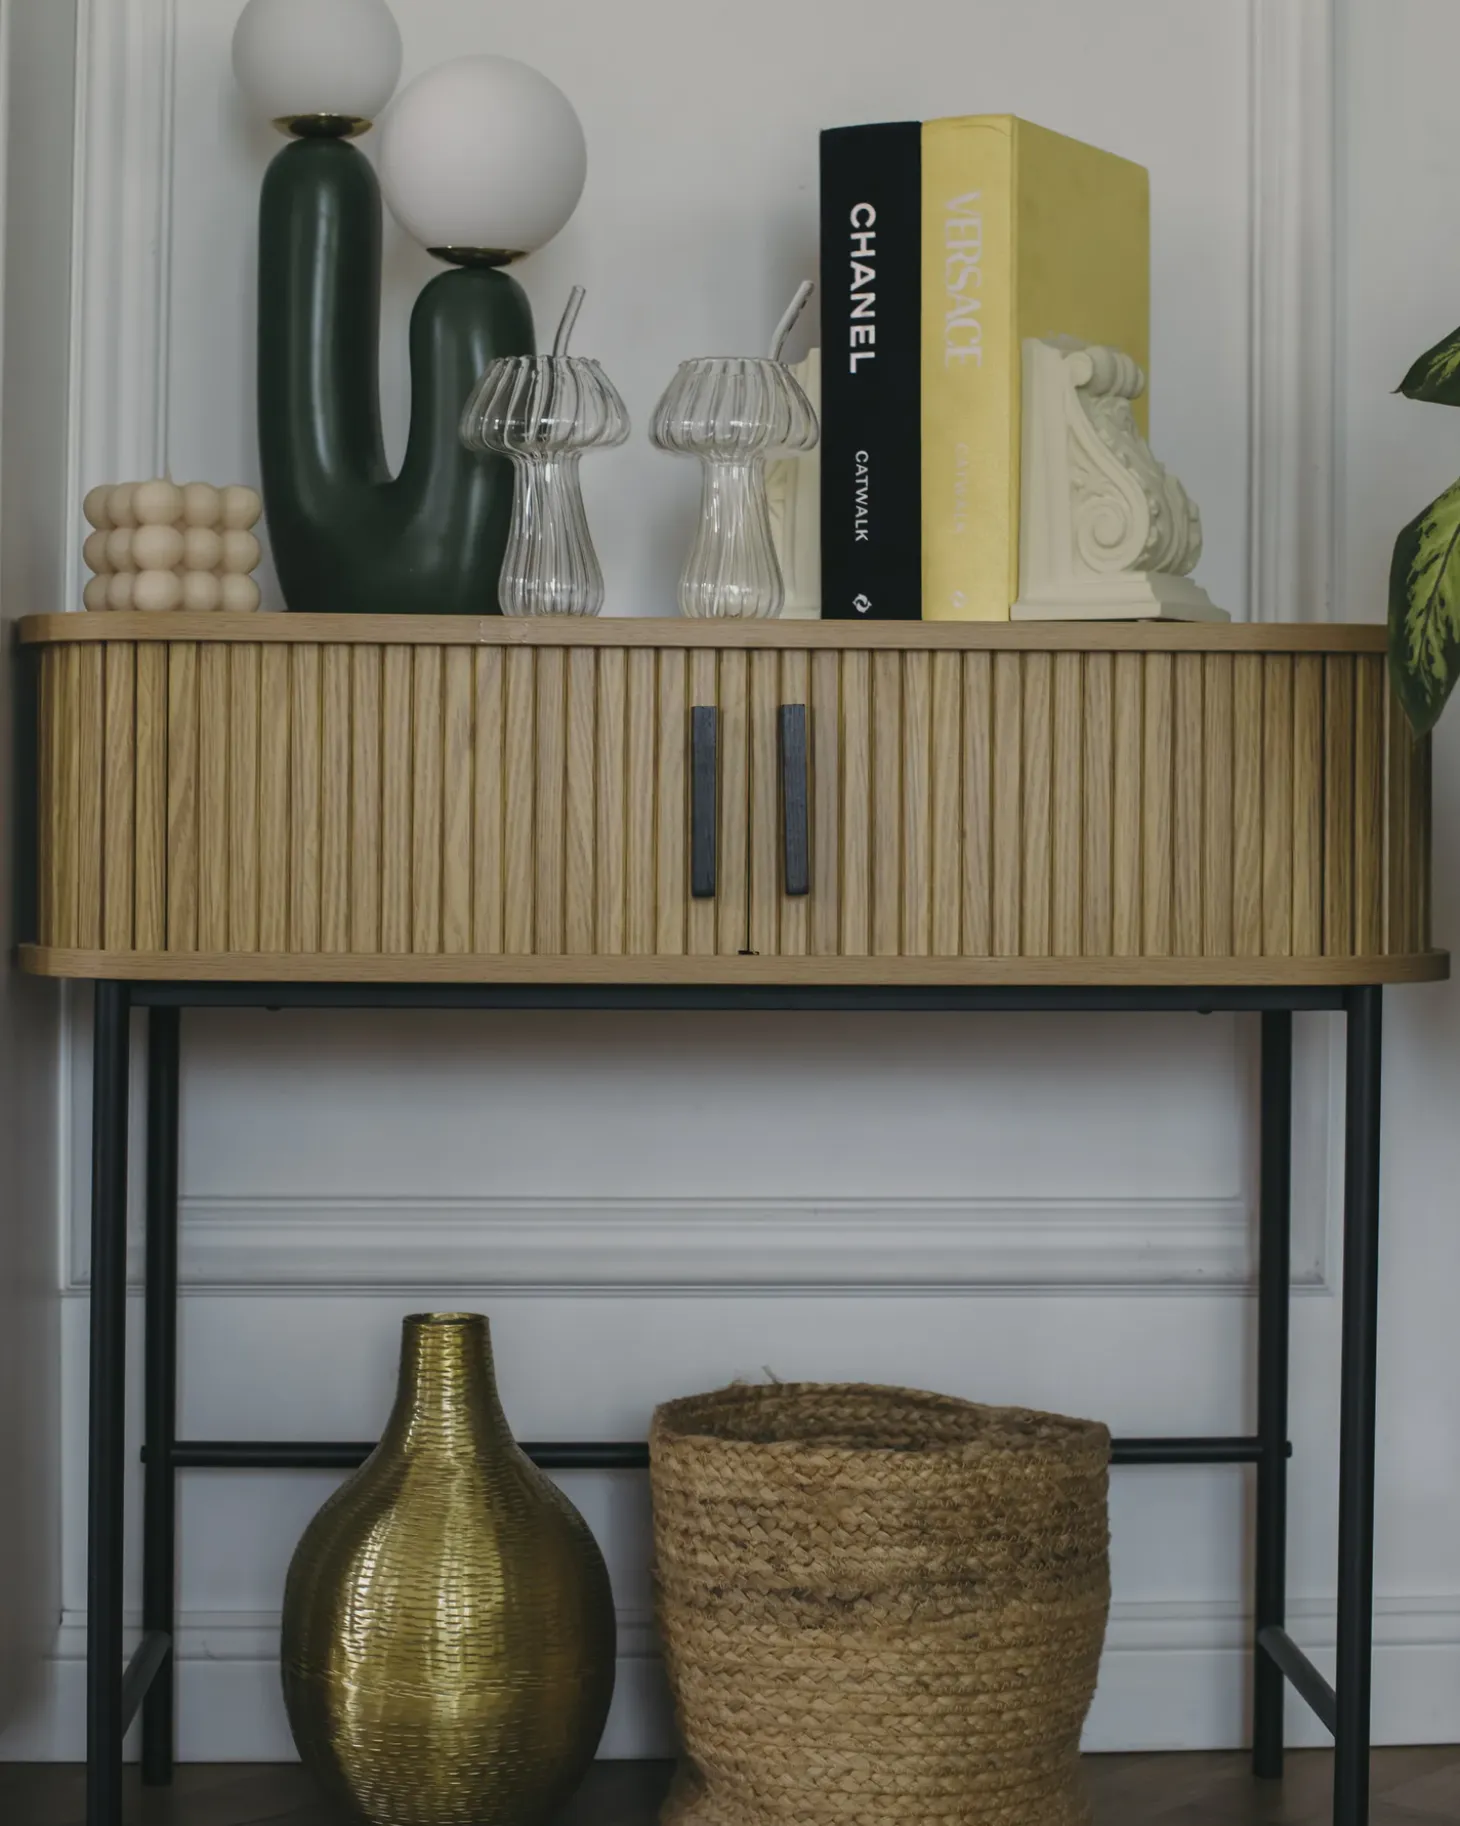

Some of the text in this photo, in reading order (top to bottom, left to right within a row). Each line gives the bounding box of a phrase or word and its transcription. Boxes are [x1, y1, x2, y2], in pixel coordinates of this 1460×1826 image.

[849, 202, 877, 374] CHANEL
[945, 190, 982, 368] VERSACE
[854, 450, 869, 542] CATWALK
